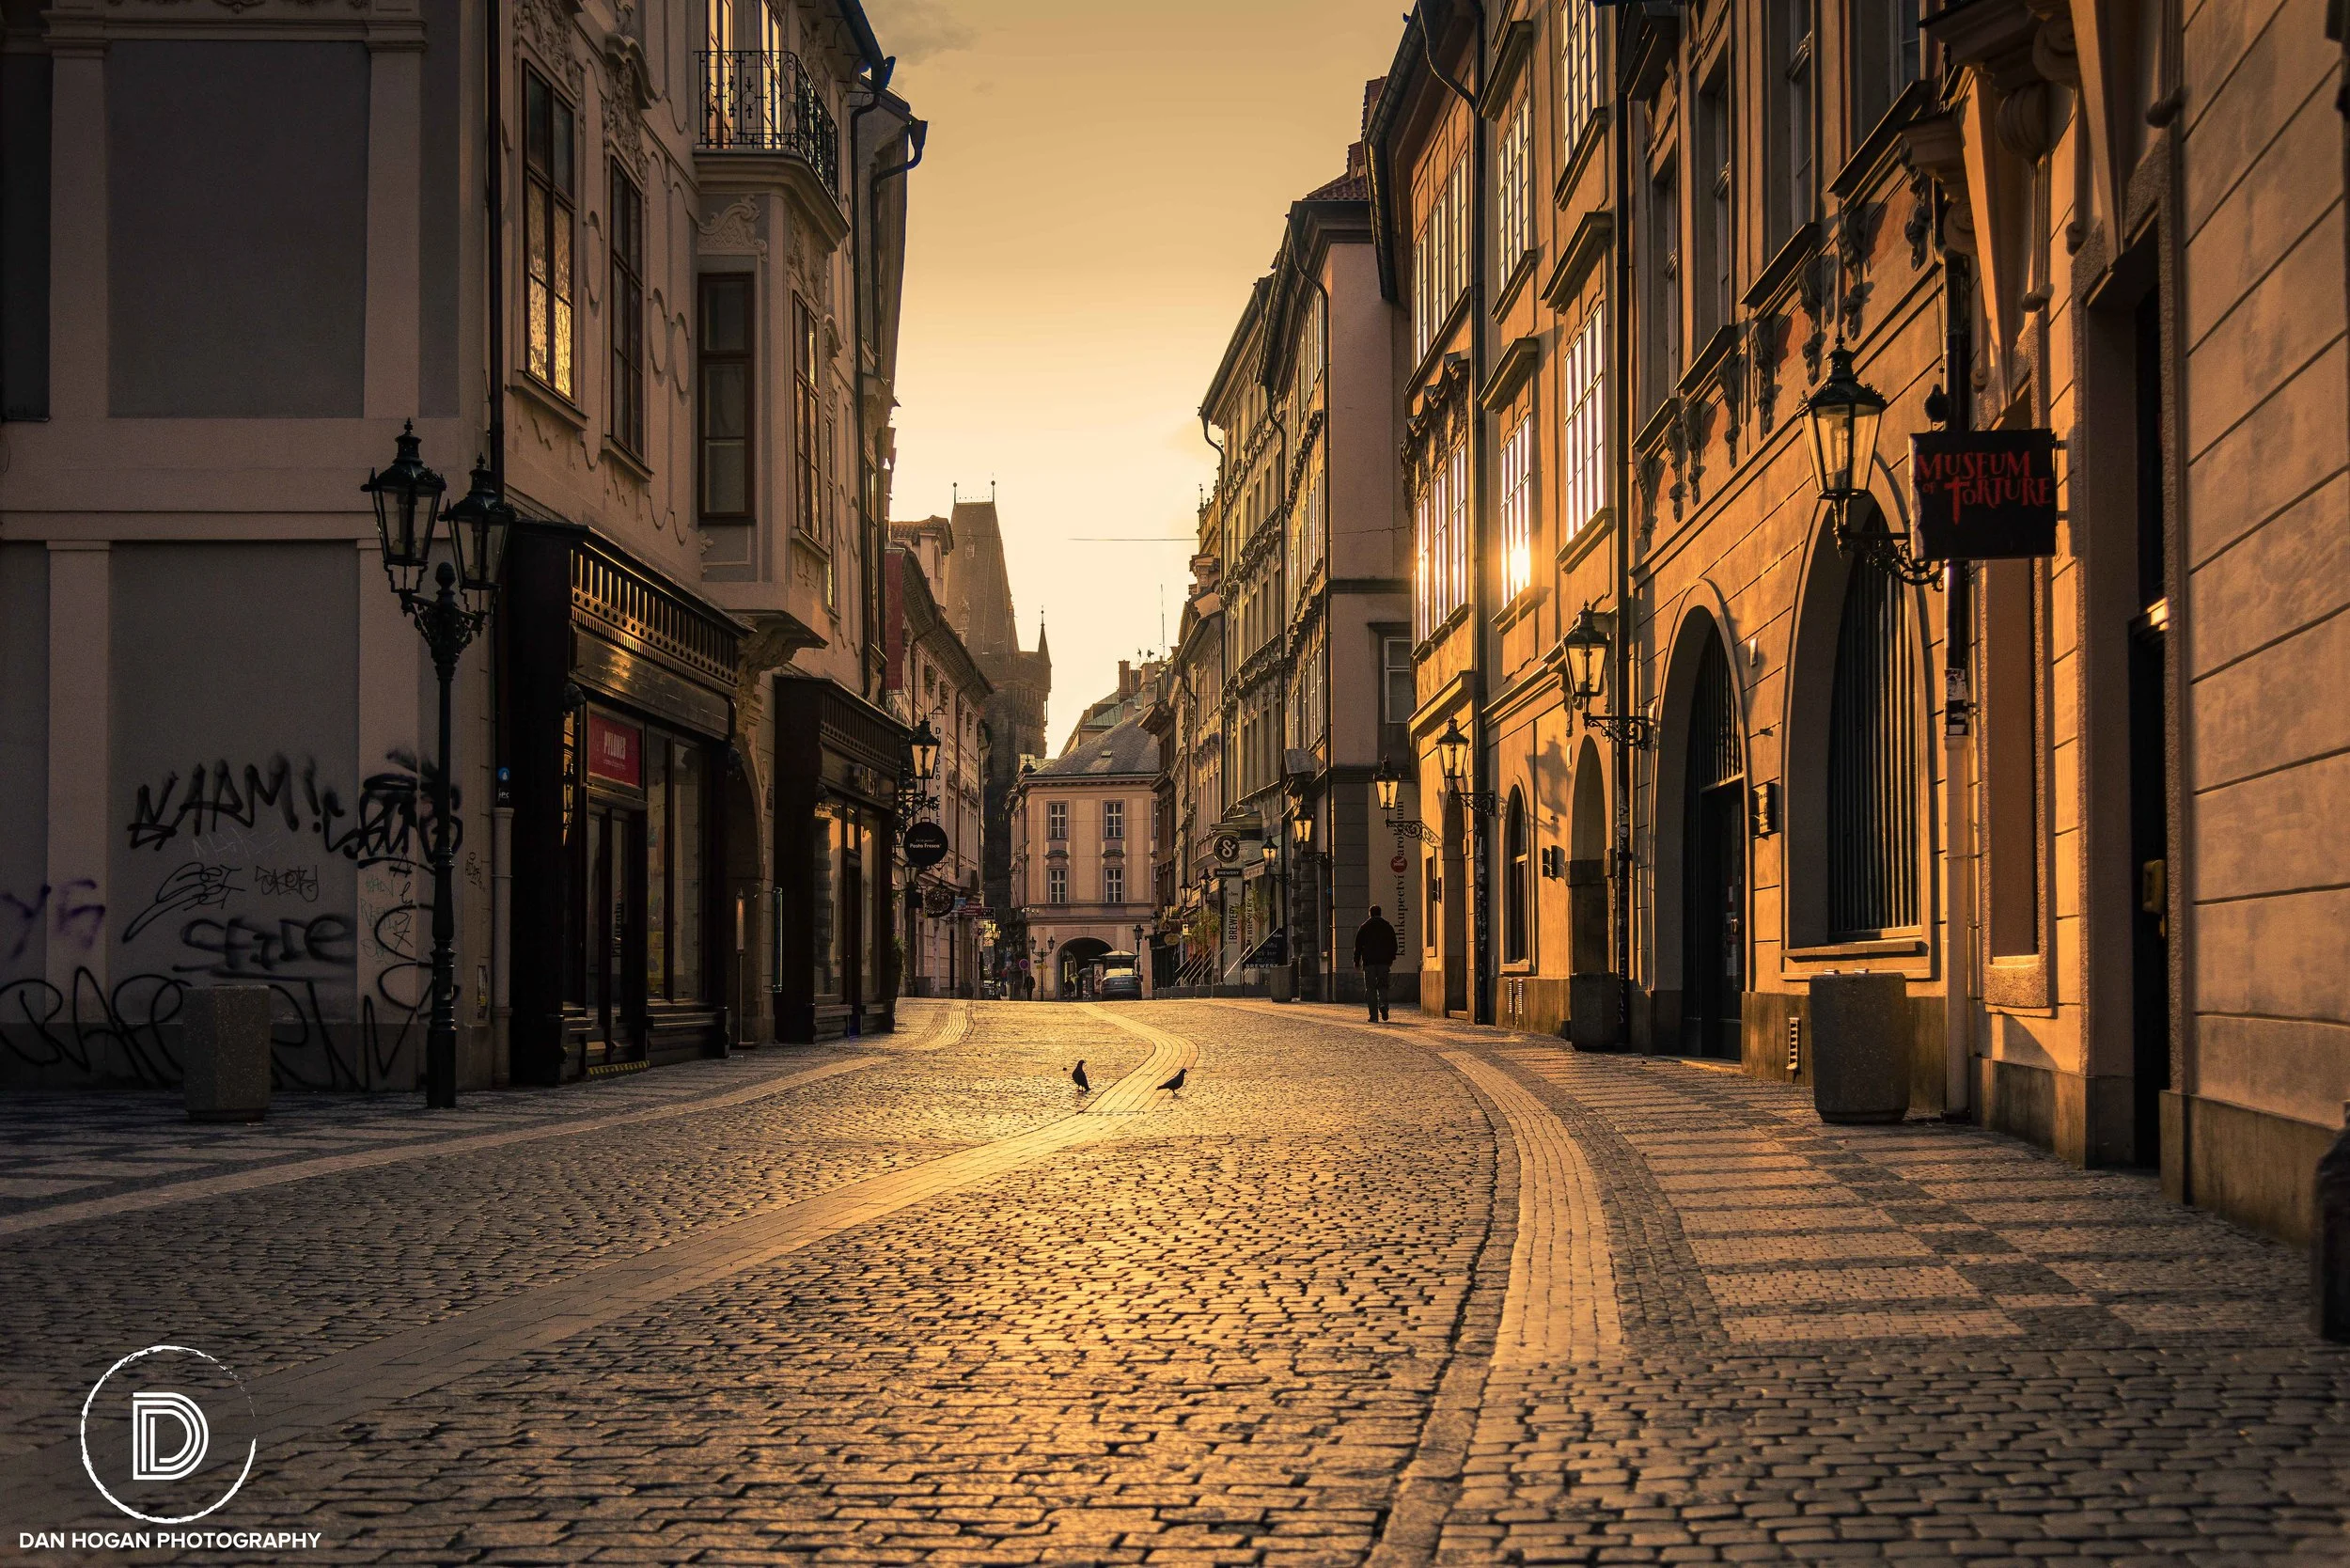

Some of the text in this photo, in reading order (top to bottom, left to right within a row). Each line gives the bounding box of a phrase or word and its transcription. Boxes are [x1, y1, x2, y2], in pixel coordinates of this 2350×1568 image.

[1918, 450, 2030, 480] MUSEUM
[1944, 476, 2053, 526] TORTURE
[1229, 904, 1238, 940] BREWERY
